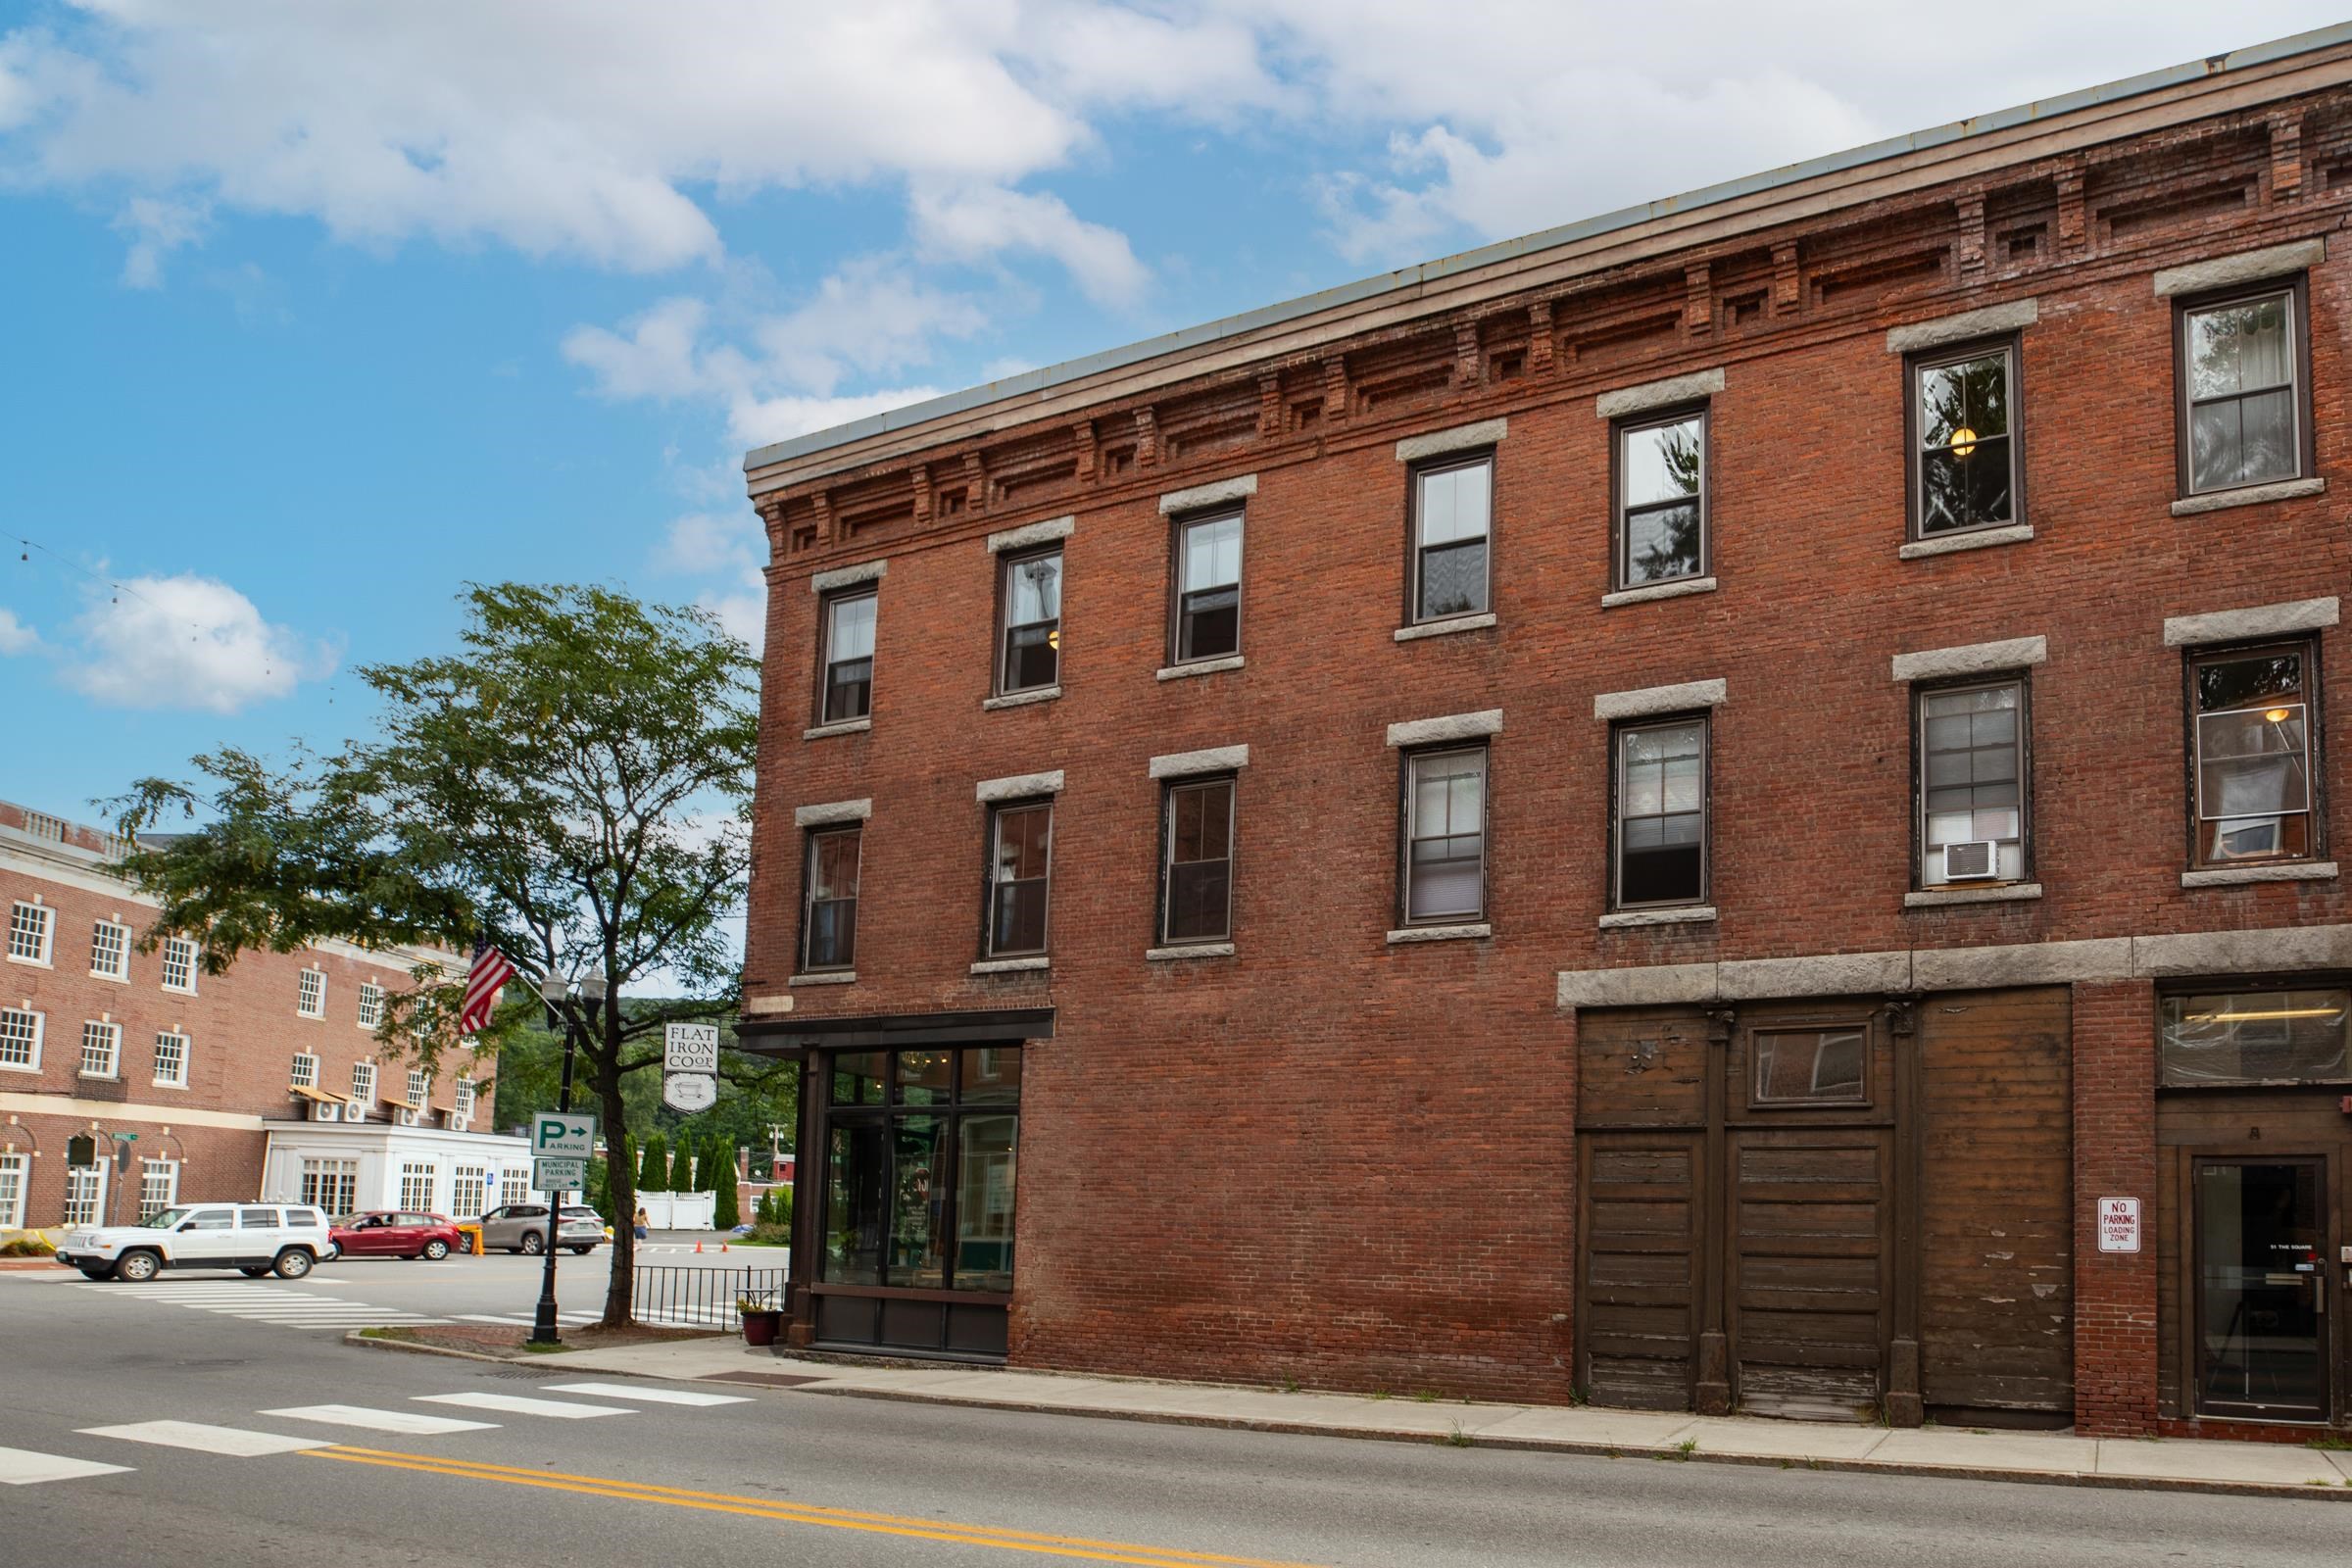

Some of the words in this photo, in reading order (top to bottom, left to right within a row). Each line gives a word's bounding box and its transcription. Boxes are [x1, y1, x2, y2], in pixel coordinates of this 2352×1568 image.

[670, 1027, 714, 1041] FLAT
[669, 1042, 713, 1055] IRON
[668, 1055, 713, 1068] COOP
[2112, 1202, 2126, 1212] NO
[2103, 1215, 2135, 1224] PARKING
